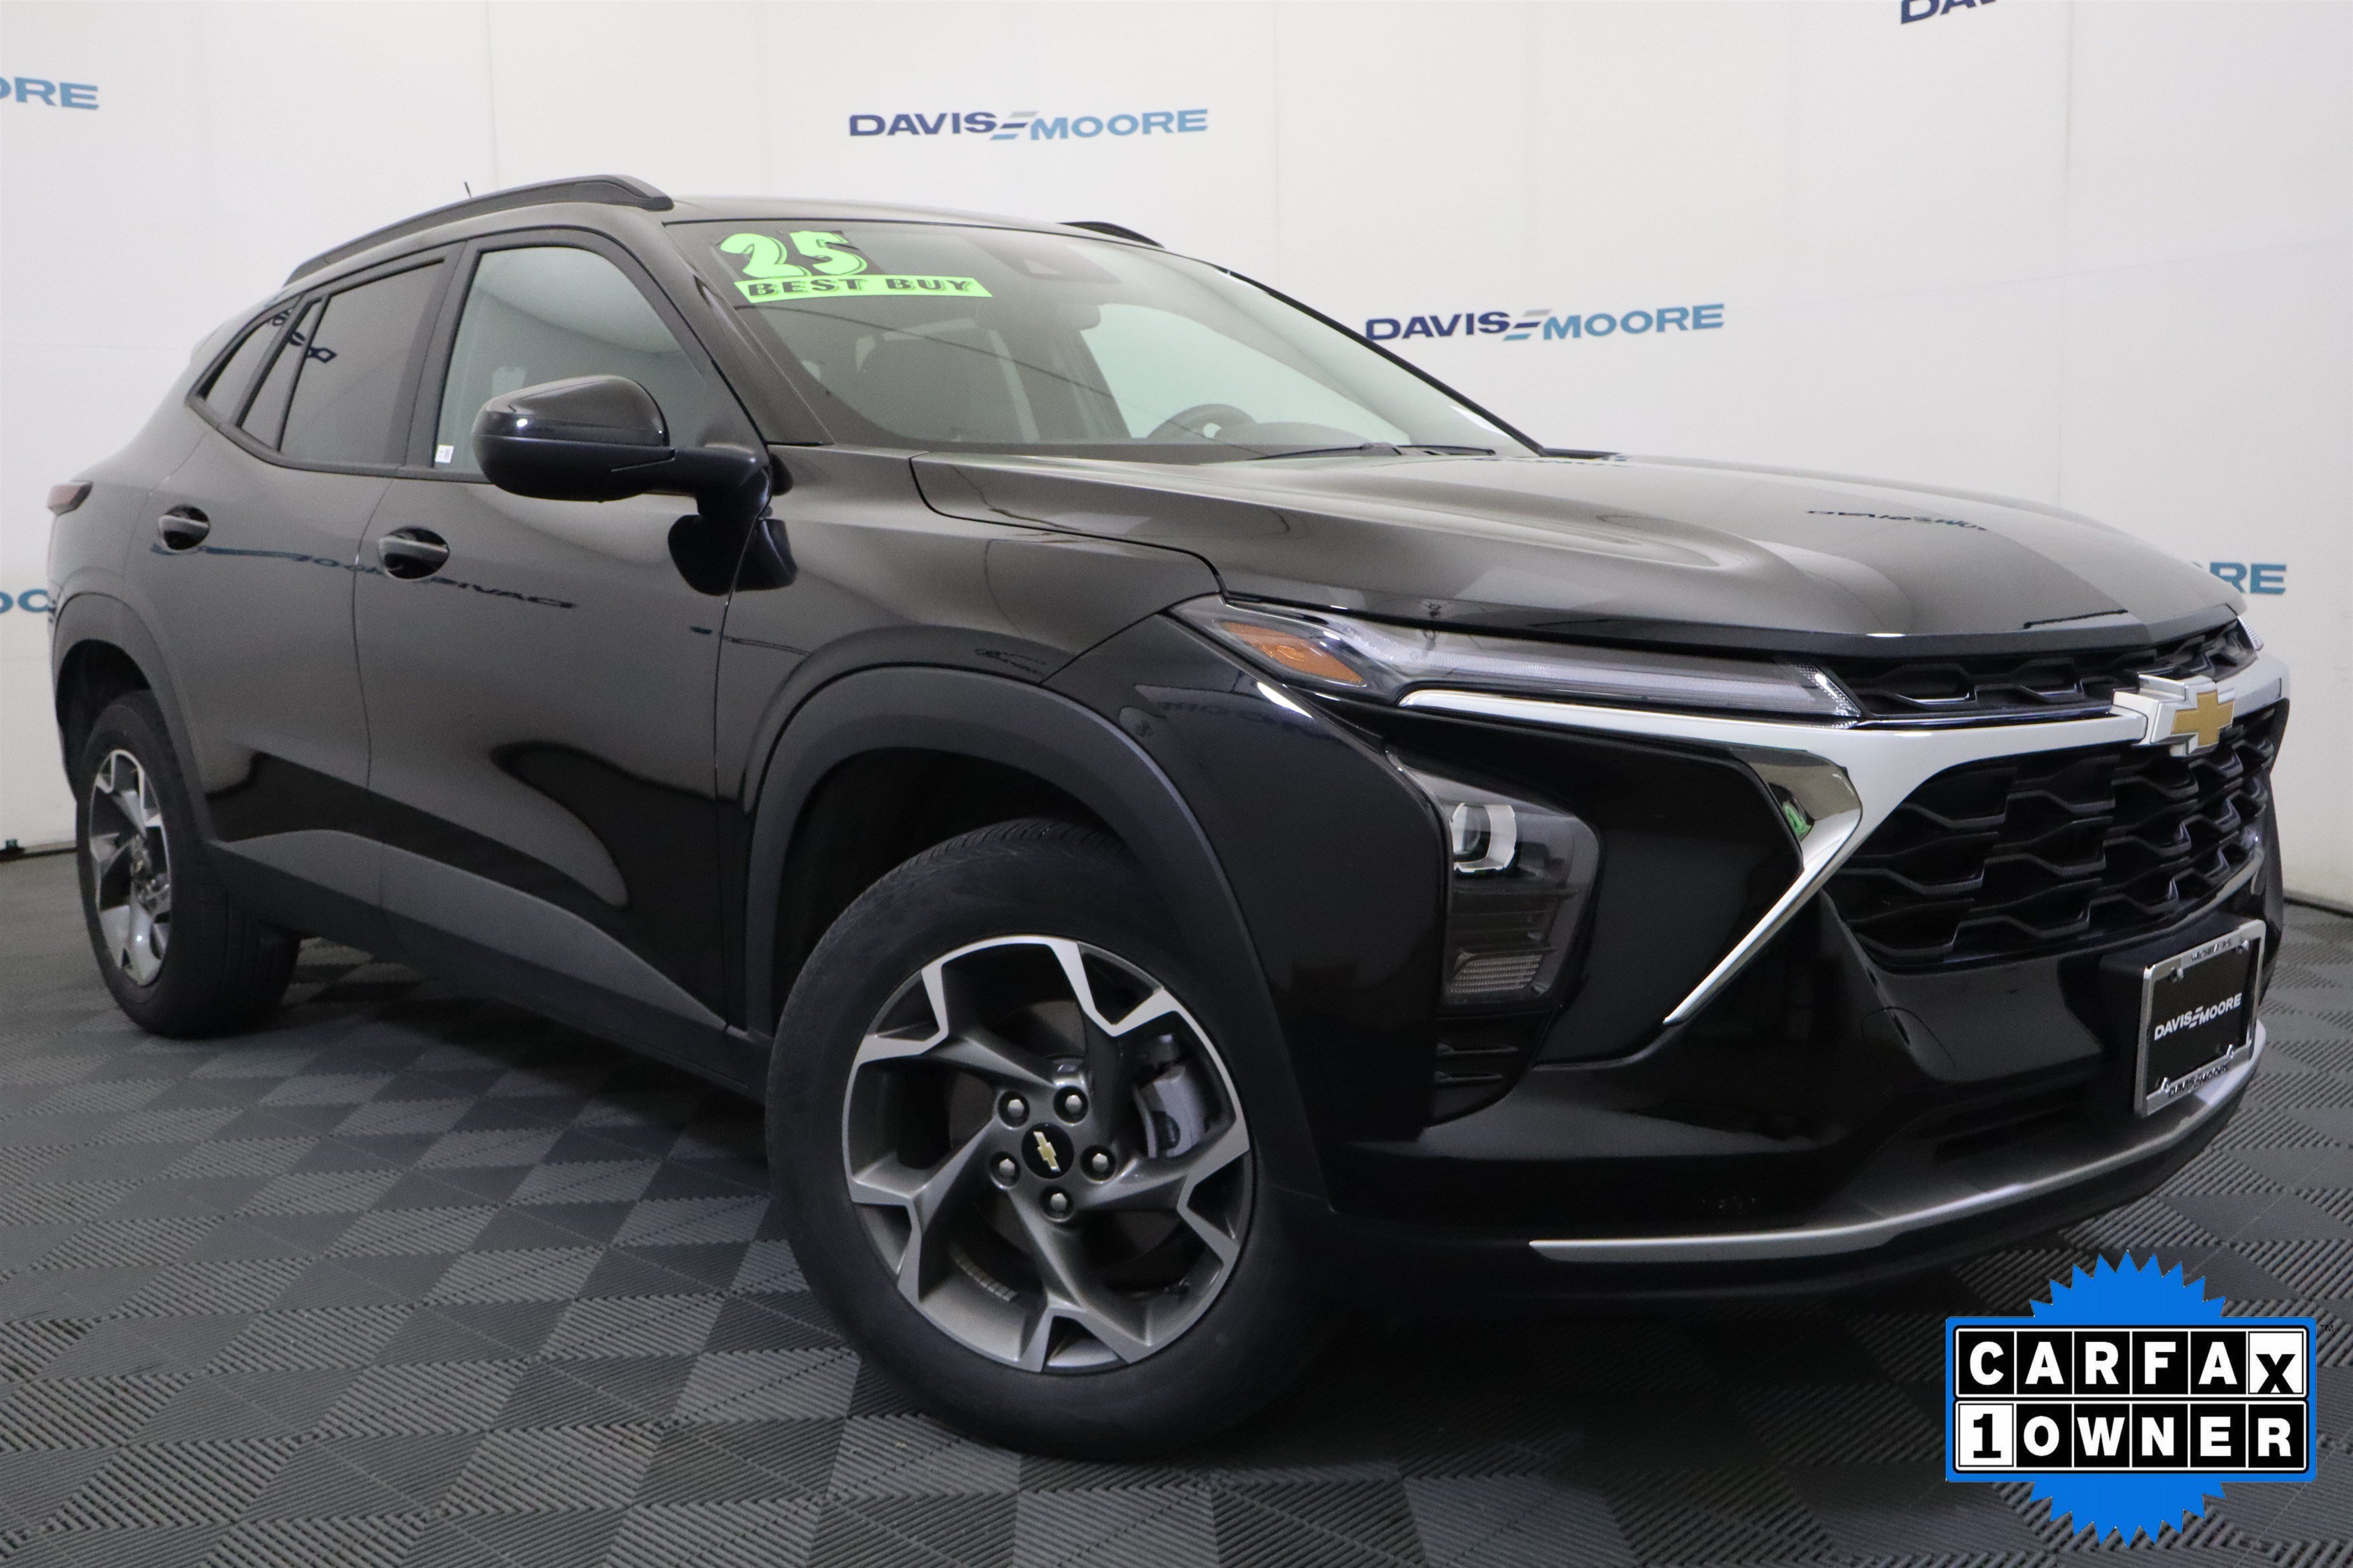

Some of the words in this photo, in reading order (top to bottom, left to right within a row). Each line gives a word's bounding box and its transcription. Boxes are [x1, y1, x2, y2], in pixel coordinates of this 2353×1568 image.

[849, 111, 997, 137] DAVIS
[1031, 109, 1208, 141] MOORE
[720, 230, 868, 277] 25
[747, 278, 867, 298] BEST
[885, 278, 972, 292] BUY
[1365, 311, 1509, 340] DAVIS
[1543, 303, 1725, 341] MOORE
[2155, 1010, 2192, 1041] DAVIS
[2199, 992, 2242, 1025] MOORE
